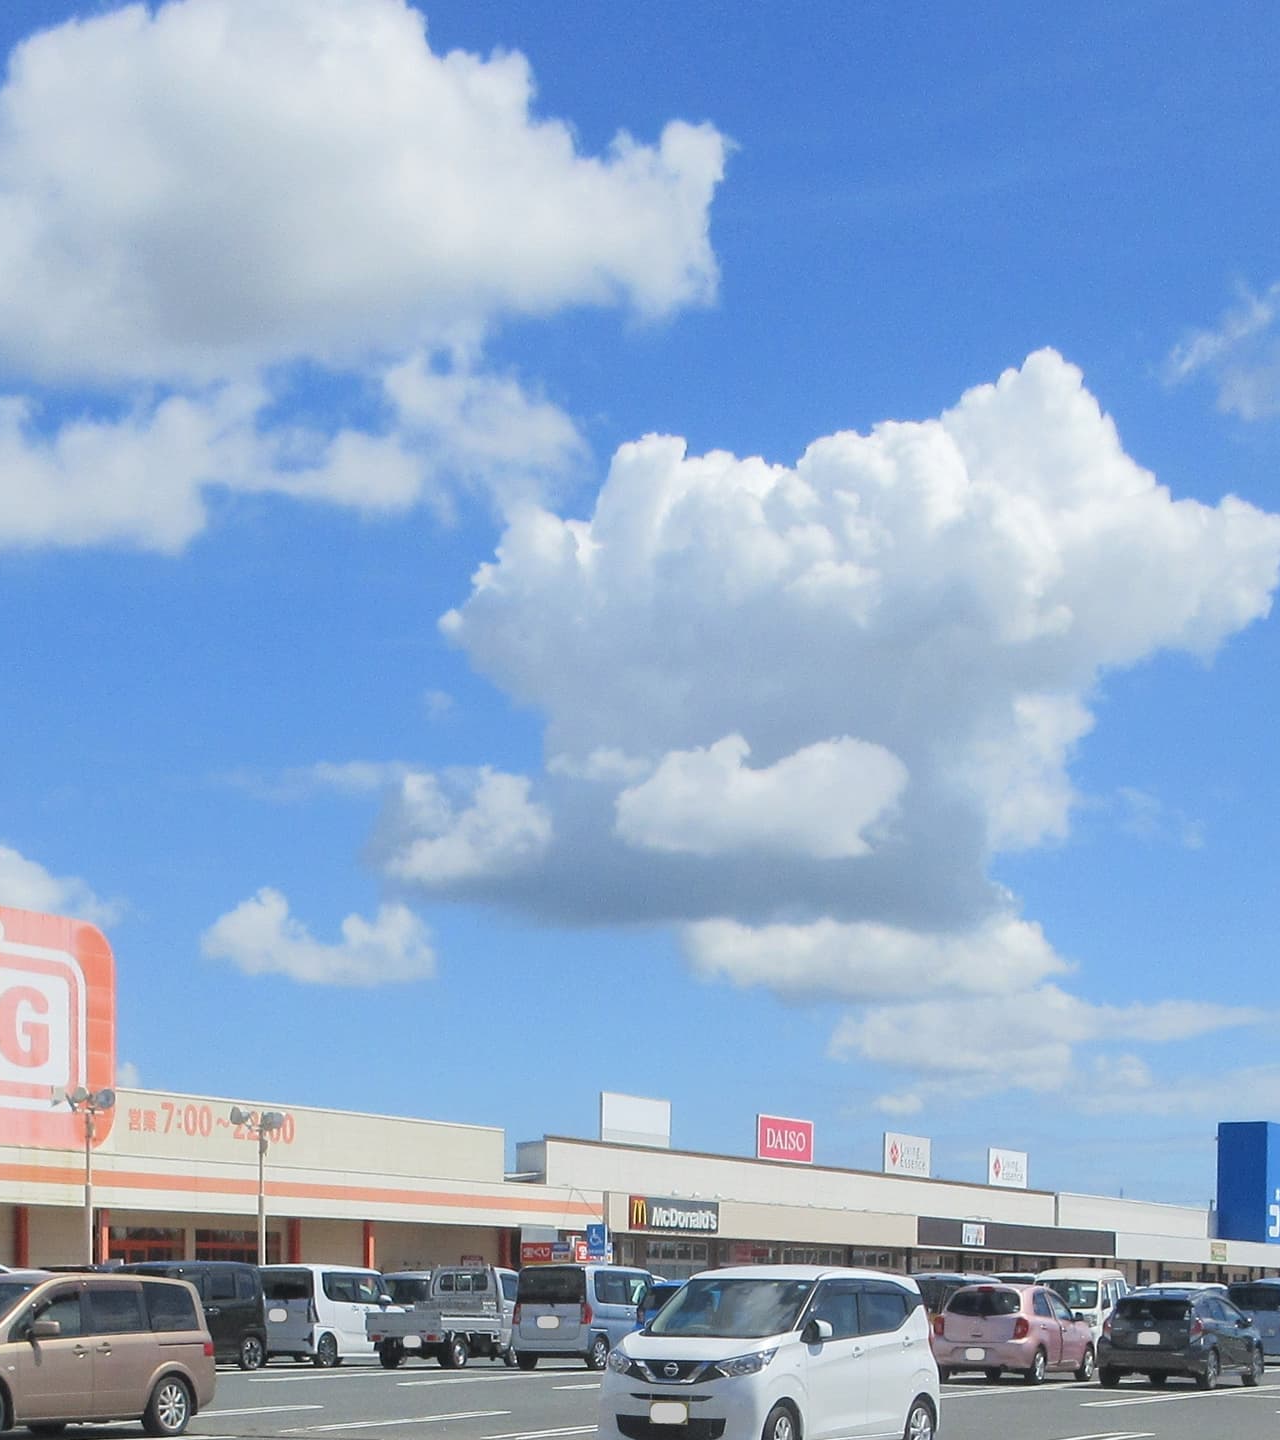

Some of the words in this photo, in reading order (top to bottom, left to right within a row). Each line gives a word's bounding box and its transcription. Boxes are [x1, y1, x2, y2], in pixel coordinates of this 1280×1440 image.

[128, 1107, 157, 1132] 営業
[766, 1127, 806, 1153] DAISO
[900, 1155, 926, 1172] Essence
[651, 1206, 717, 1231] McDonald's
